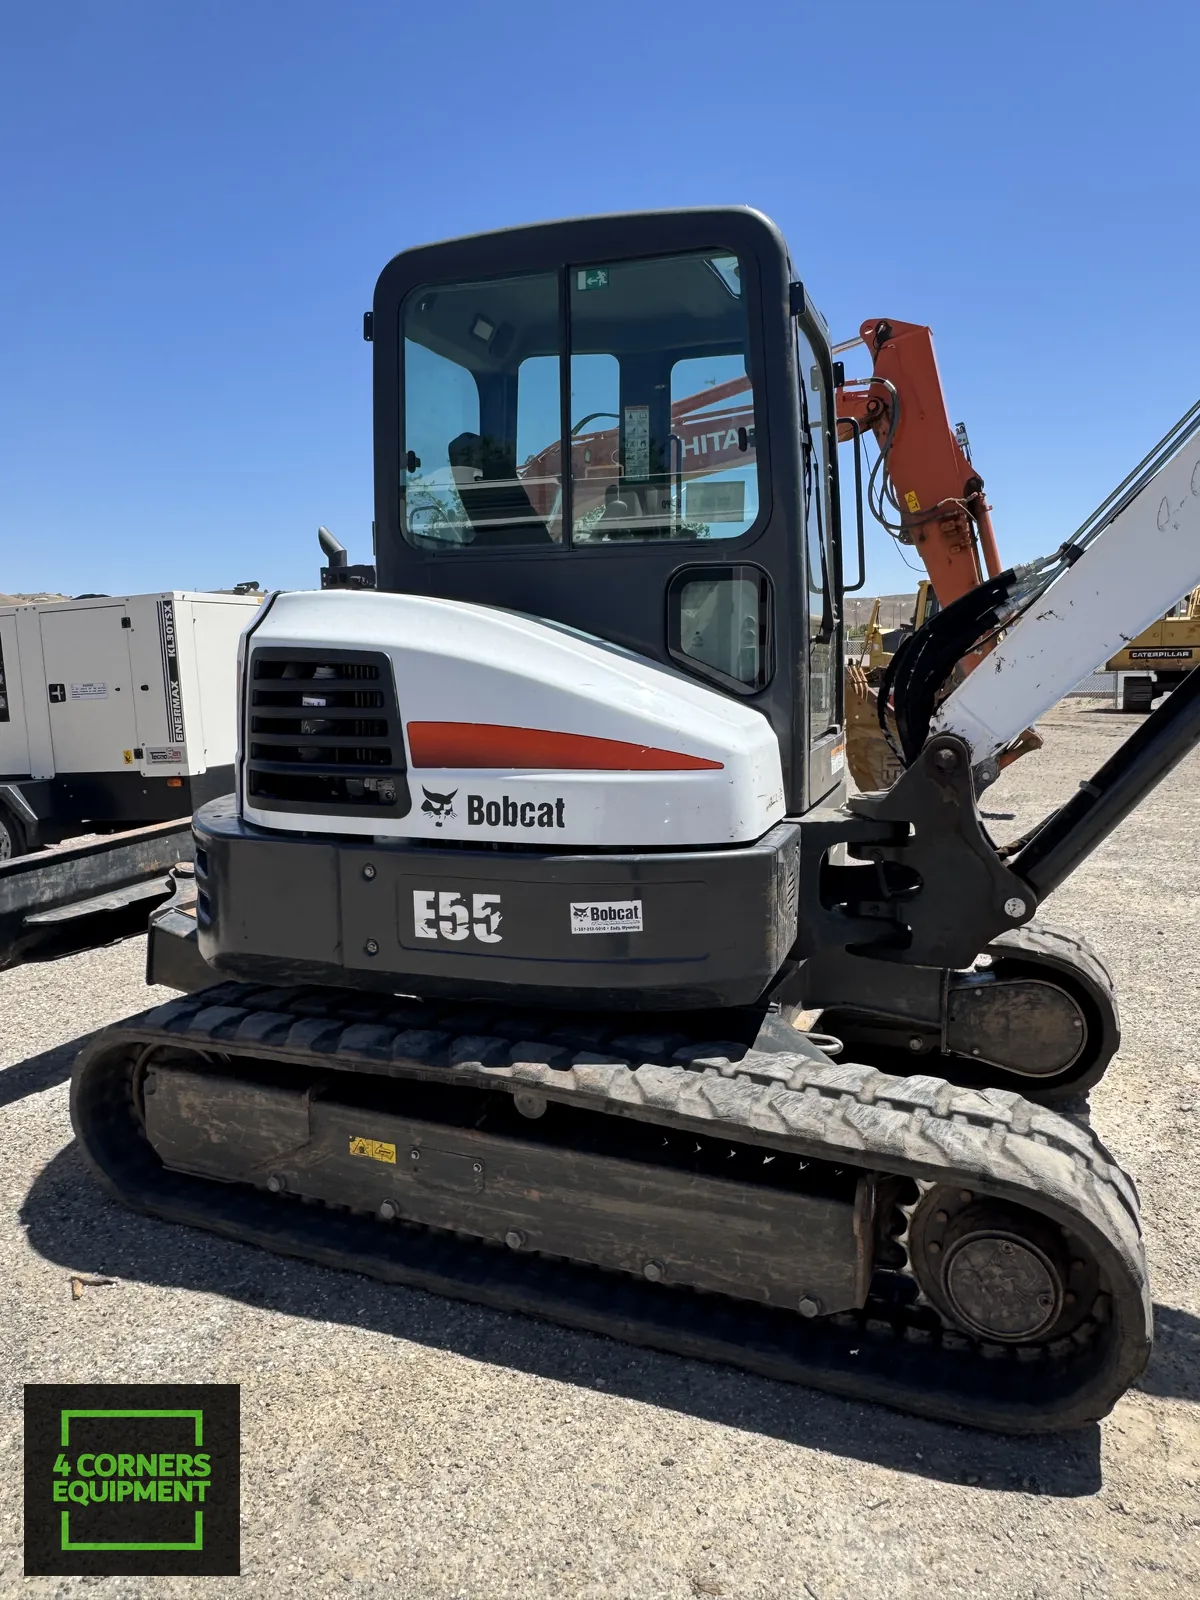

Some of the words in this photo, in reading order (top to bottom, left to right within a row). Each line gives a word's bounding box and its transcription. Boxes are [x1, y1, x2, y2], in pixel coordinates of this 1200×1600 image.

[170, 680, 184, 742] ENERMAX
[467, 794, 565, 828] Bobcat
[413, 890, 503, 943] E55
[590, 905, 639, 921] Bobcat
